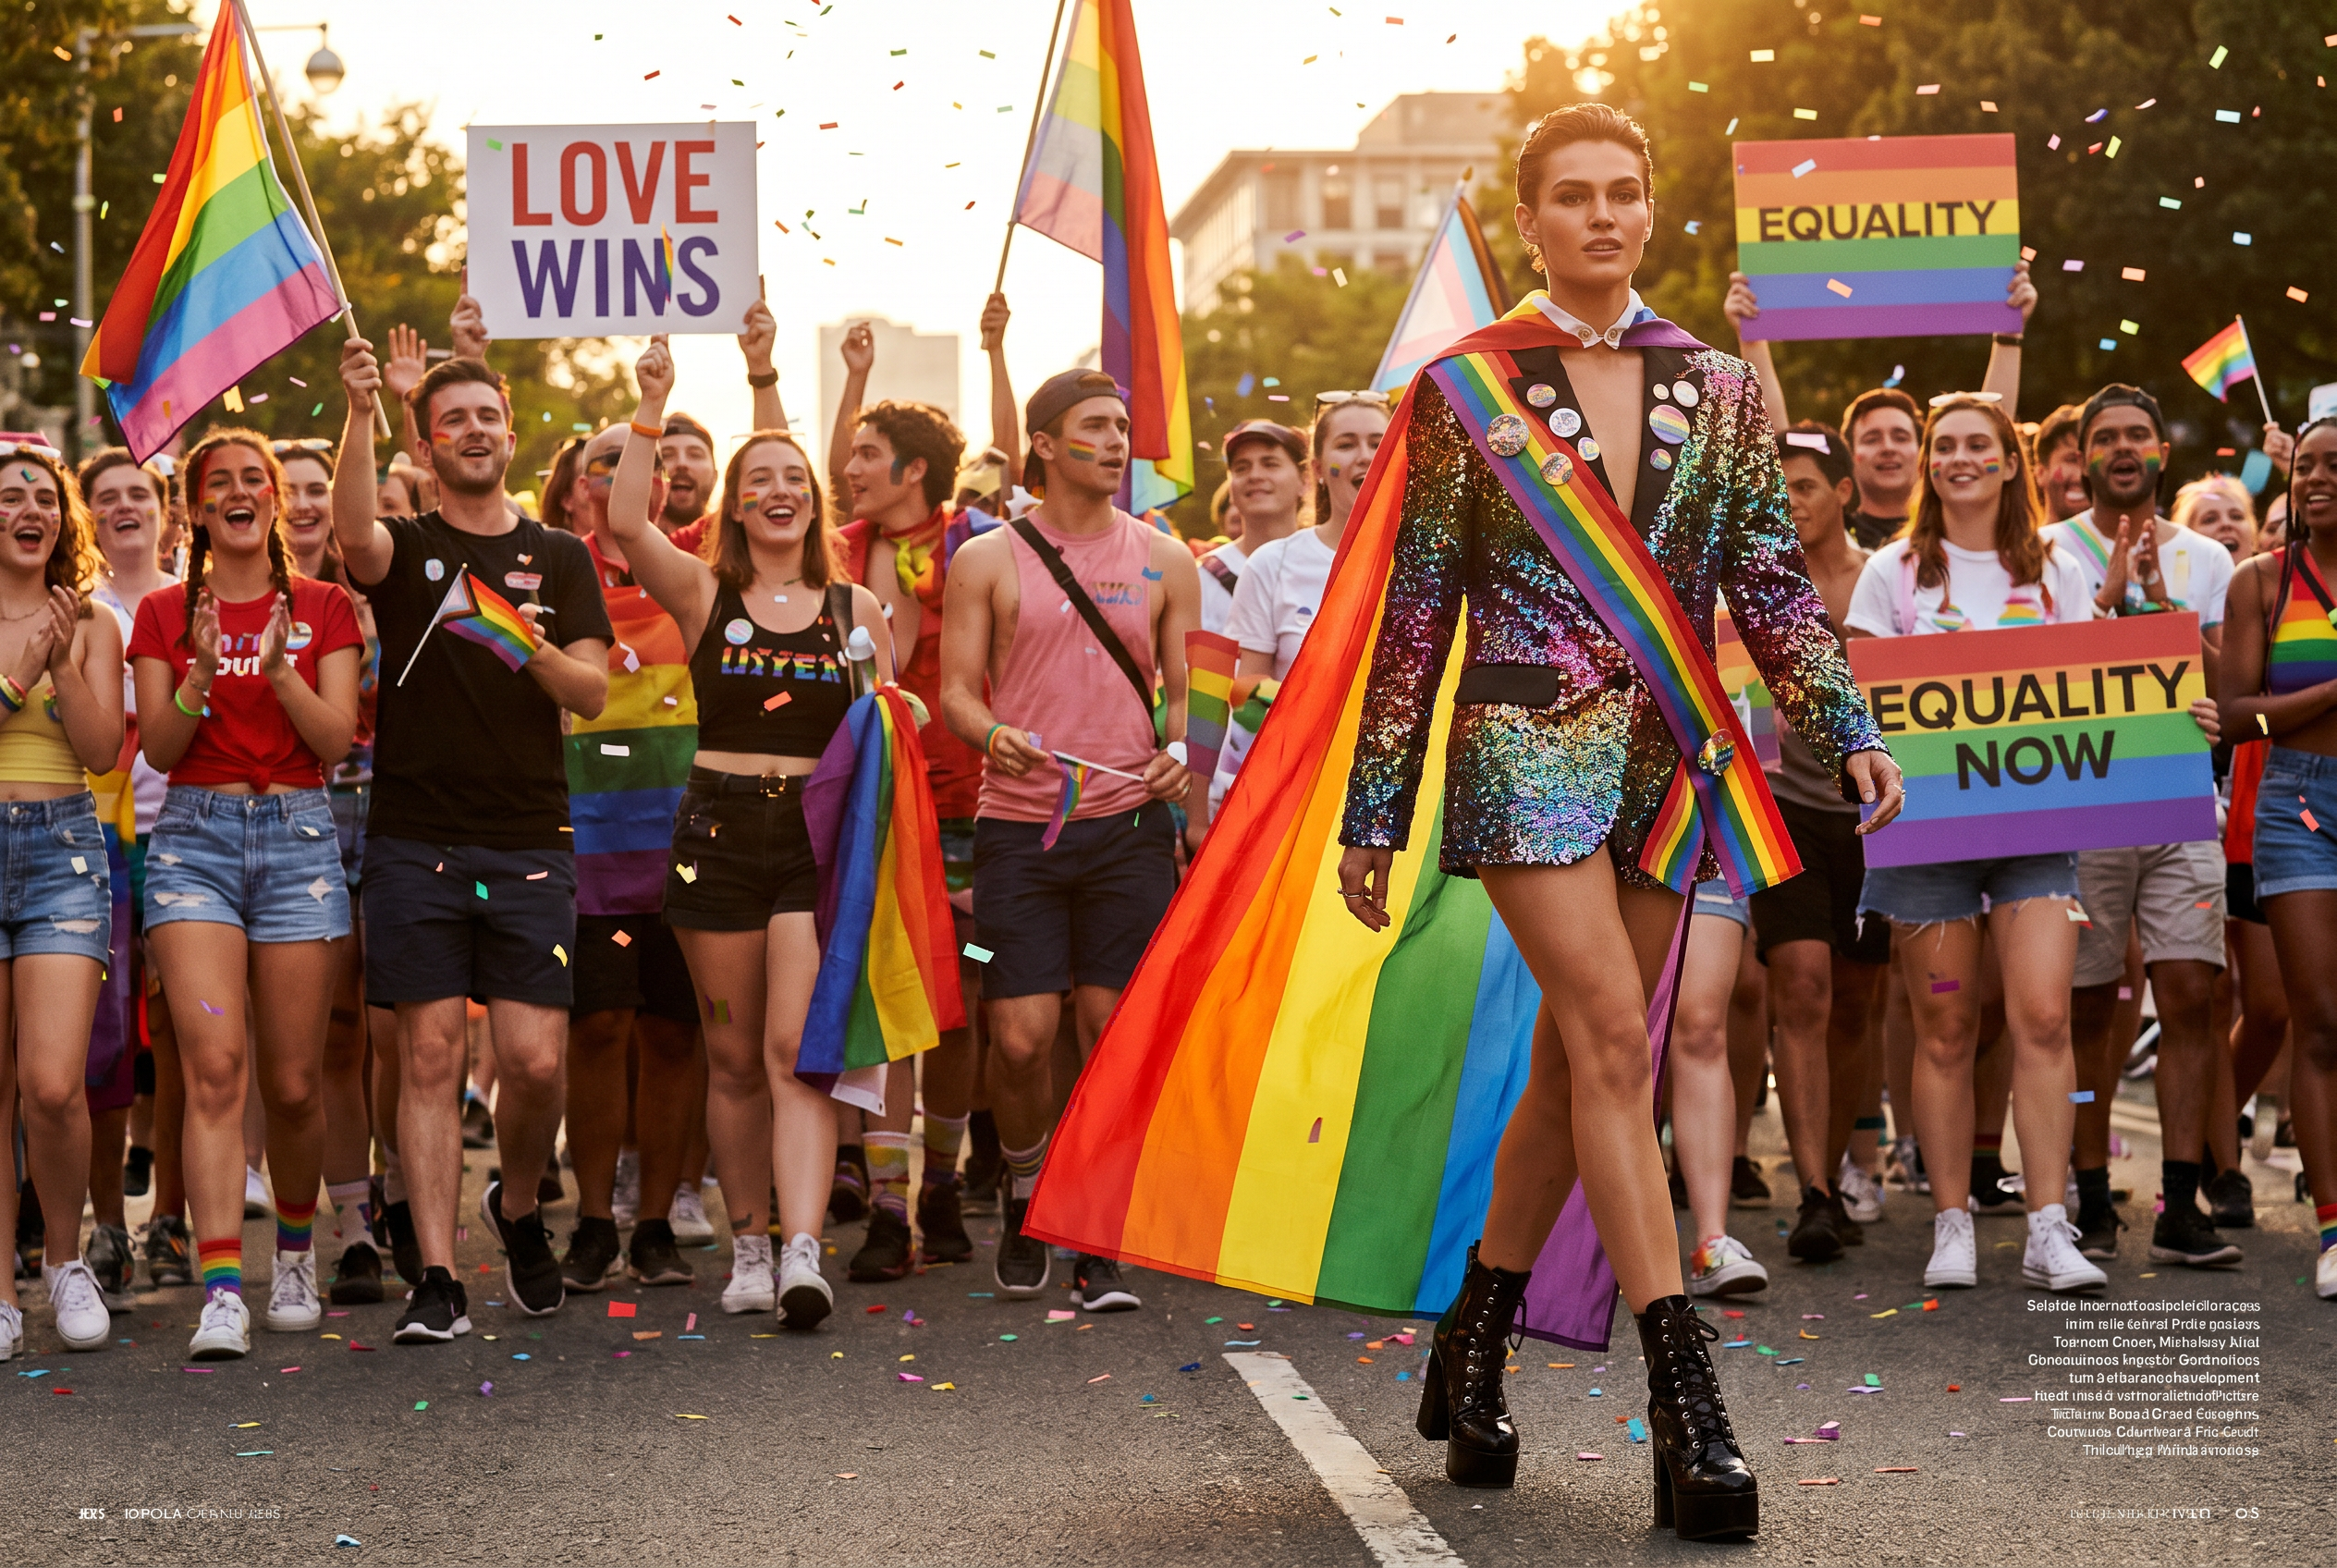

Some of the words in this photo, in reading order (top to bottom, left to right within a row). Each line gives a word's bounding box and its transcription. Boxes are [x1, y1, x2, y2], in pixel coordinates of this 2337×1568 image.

[512, 141, 719, 227] LOVE
[1758, 200, 1998, 242] EQUALITY
[511, 236, 720, 319] WINS
[1870, 661, 2191, 733] EQUALITY
[1955, 729, 2116, 790] NOW
